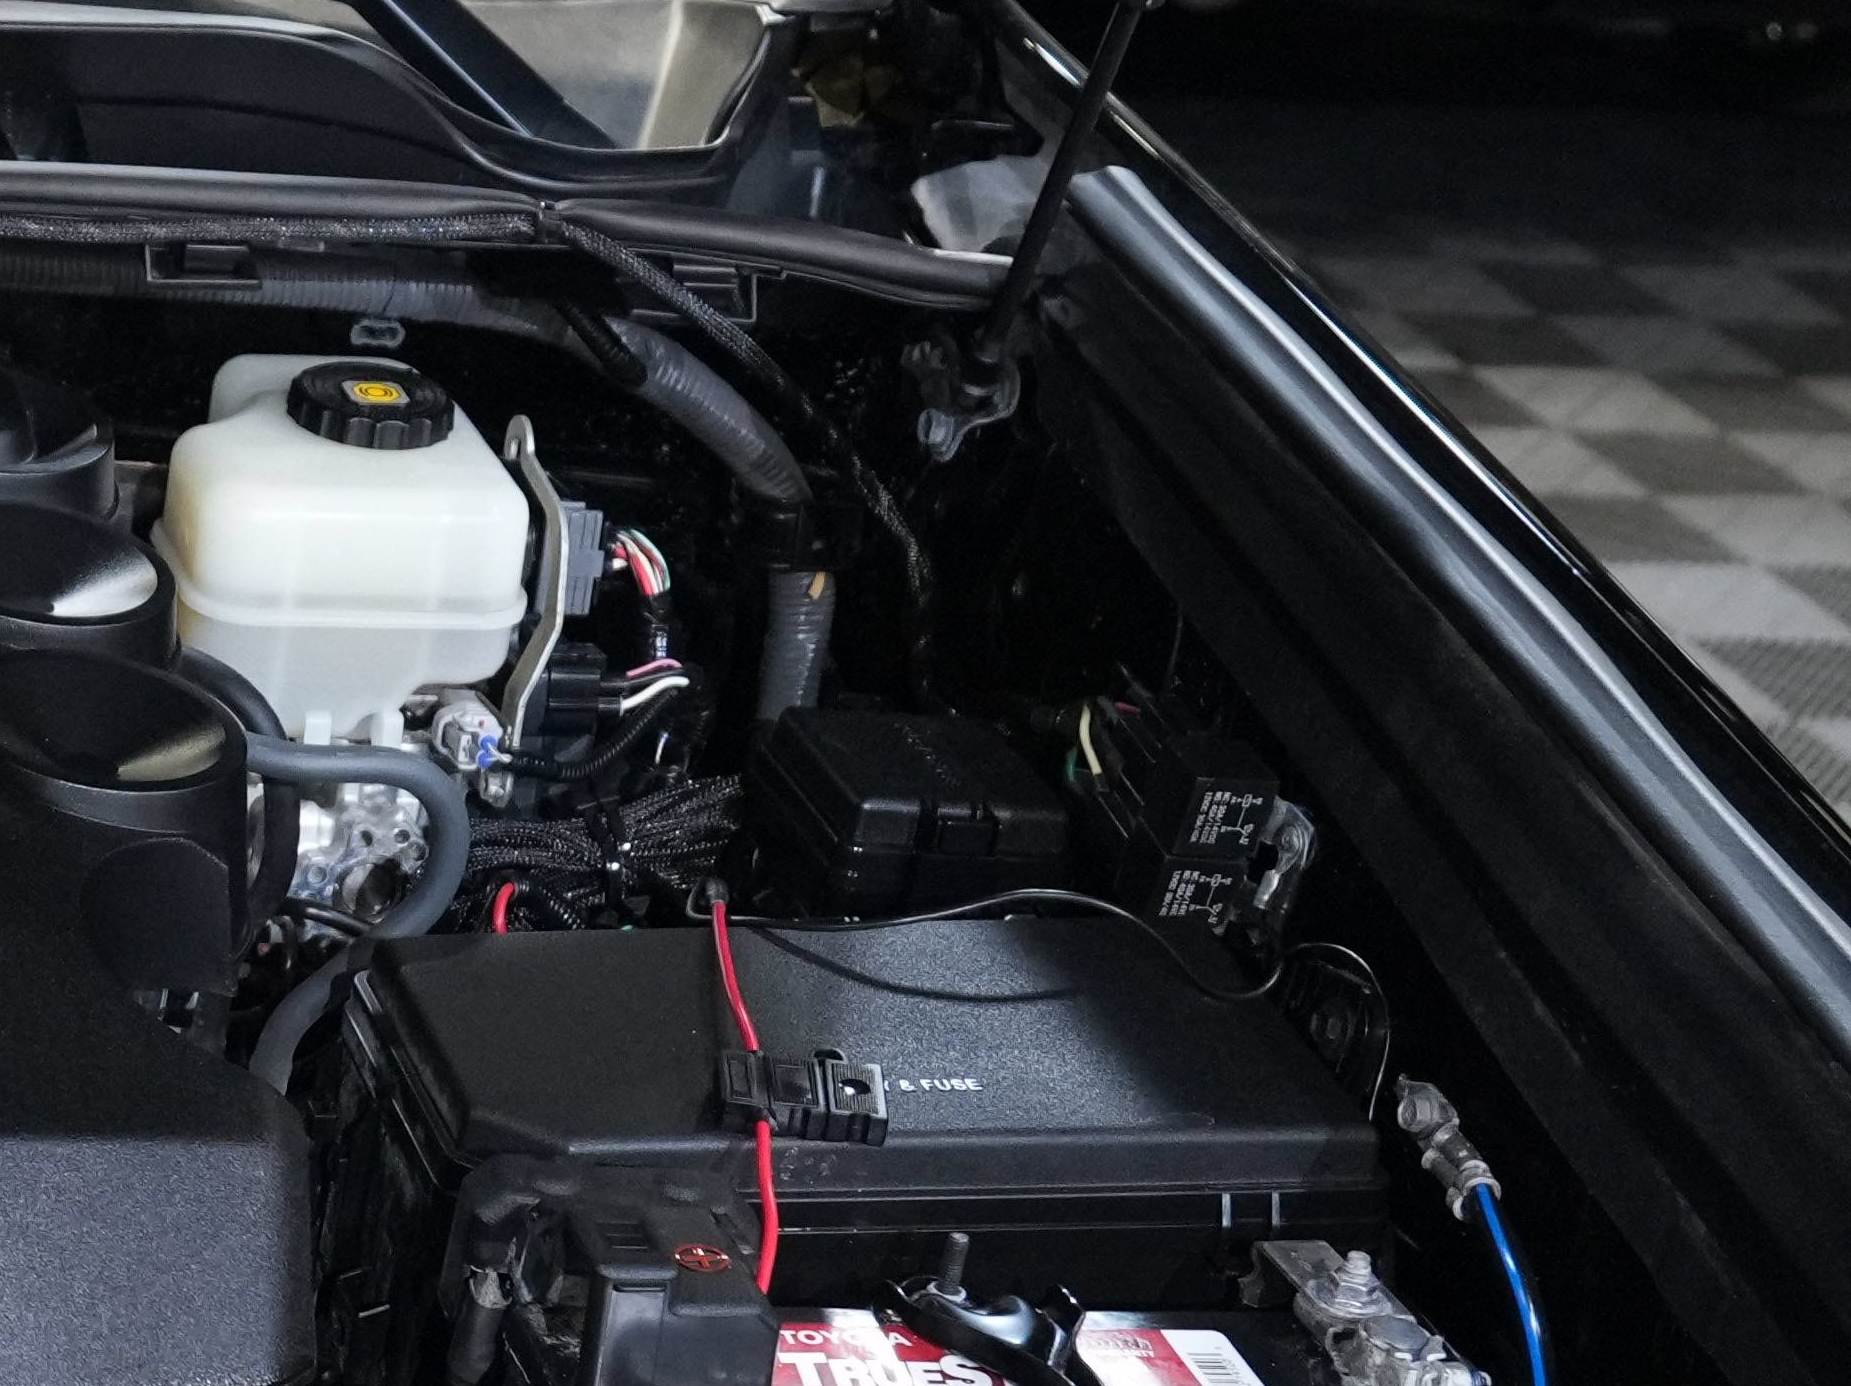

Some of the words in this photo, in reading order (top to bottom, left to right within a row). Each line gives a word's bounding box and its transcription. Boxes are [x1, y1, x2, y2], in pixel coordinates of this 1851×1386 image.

[899, 1078, 918, 1092] &
[919, 1078, 984, 1092] FUSE
[778, 1330, 913, 1348] TOYOA
